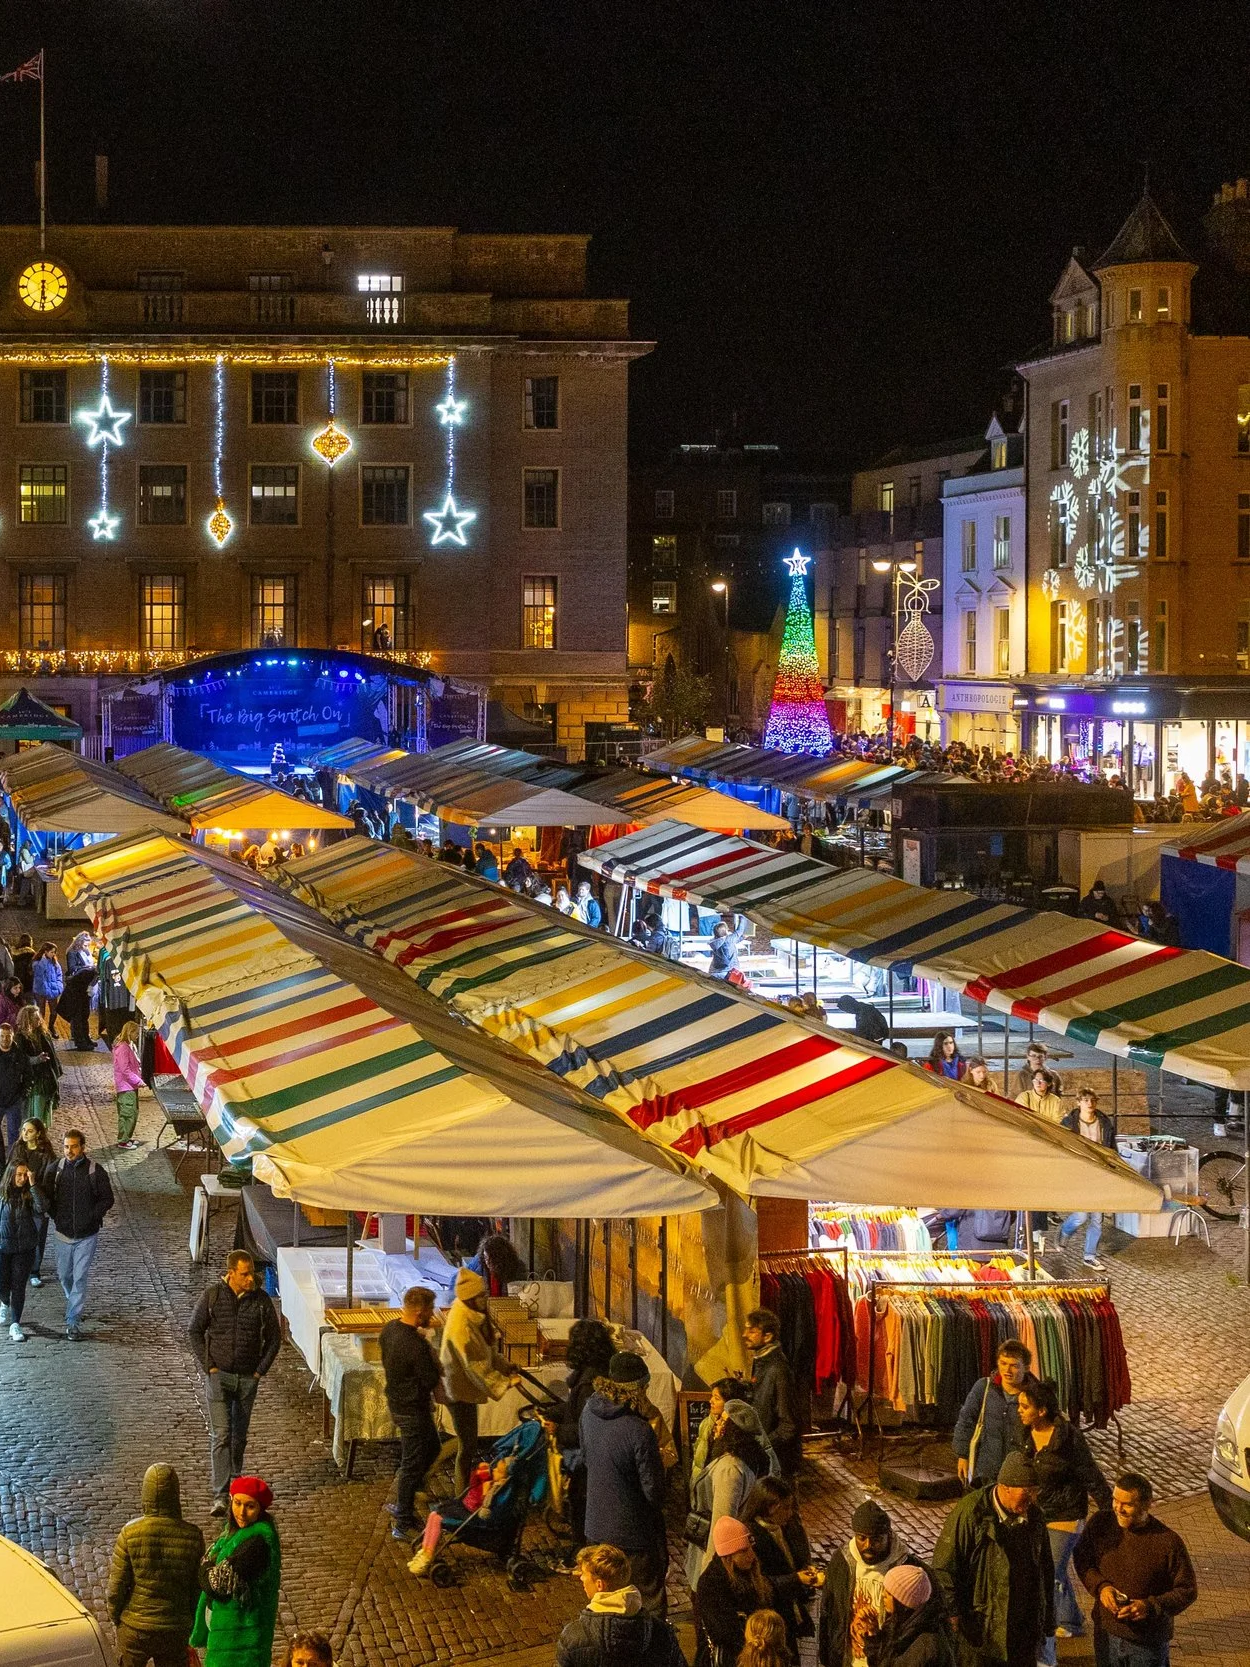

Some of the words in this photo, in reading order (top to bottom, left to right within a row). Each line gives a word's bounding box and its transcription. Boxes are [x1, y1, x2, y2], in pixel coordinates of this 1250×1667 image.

[252, 689, 299, 697] CAMBRIDGE
[951, 693, 1007, 705] ANTHROPOLOGIE
[207, 708, 234, 725] The
[238, 707, 266, 732] Big
[267, 705, 319, 724] Switch
[322, 705, 343, 722] On
